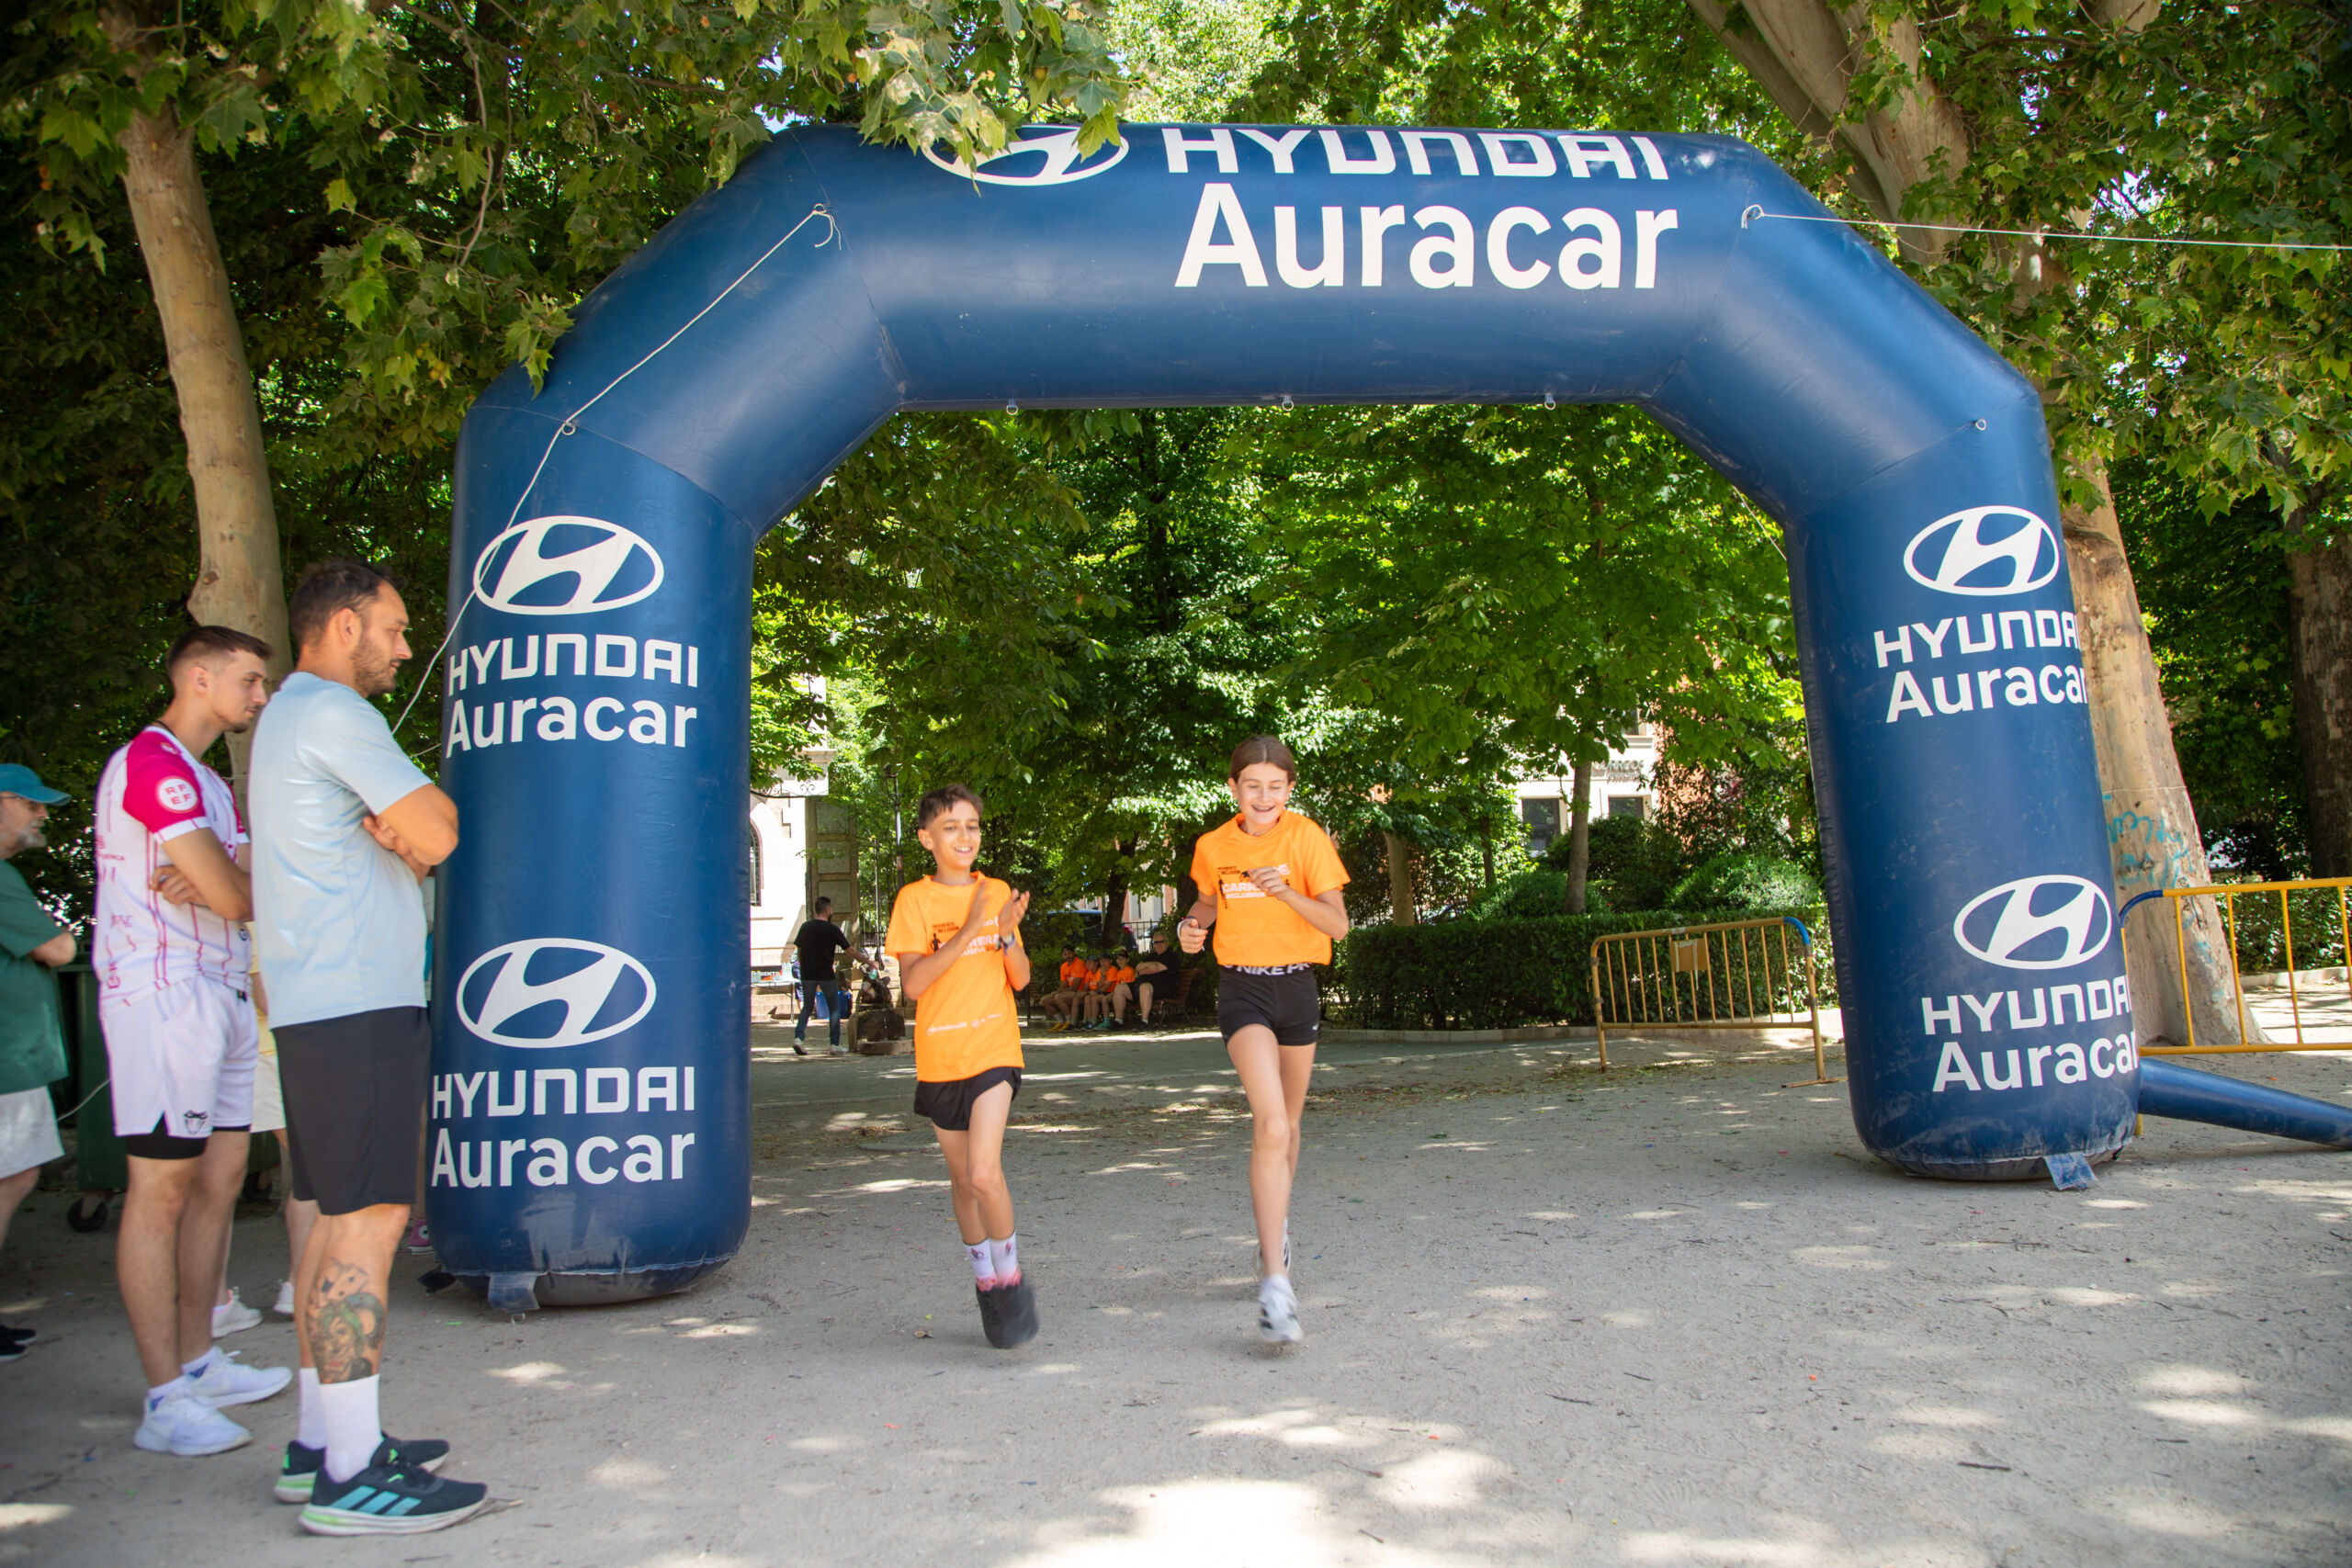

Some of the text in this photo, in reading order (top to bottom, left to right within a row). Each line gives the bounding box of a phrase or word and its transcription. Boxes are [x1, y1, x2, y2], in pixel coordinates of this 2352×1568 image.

[1161, 128, 1668, 179] HYUNDAI
[1174, 183, 1679, 289] Auracar
[448, 634, 698, 696] HYUNDAI
[446, 696, 697, 759] Auracar
[1237, 964, 1285, 976] NIKE
[432, 1066, 695, 1119] HYUNDAI
[431, 1128, 695, 1189] Auracar
